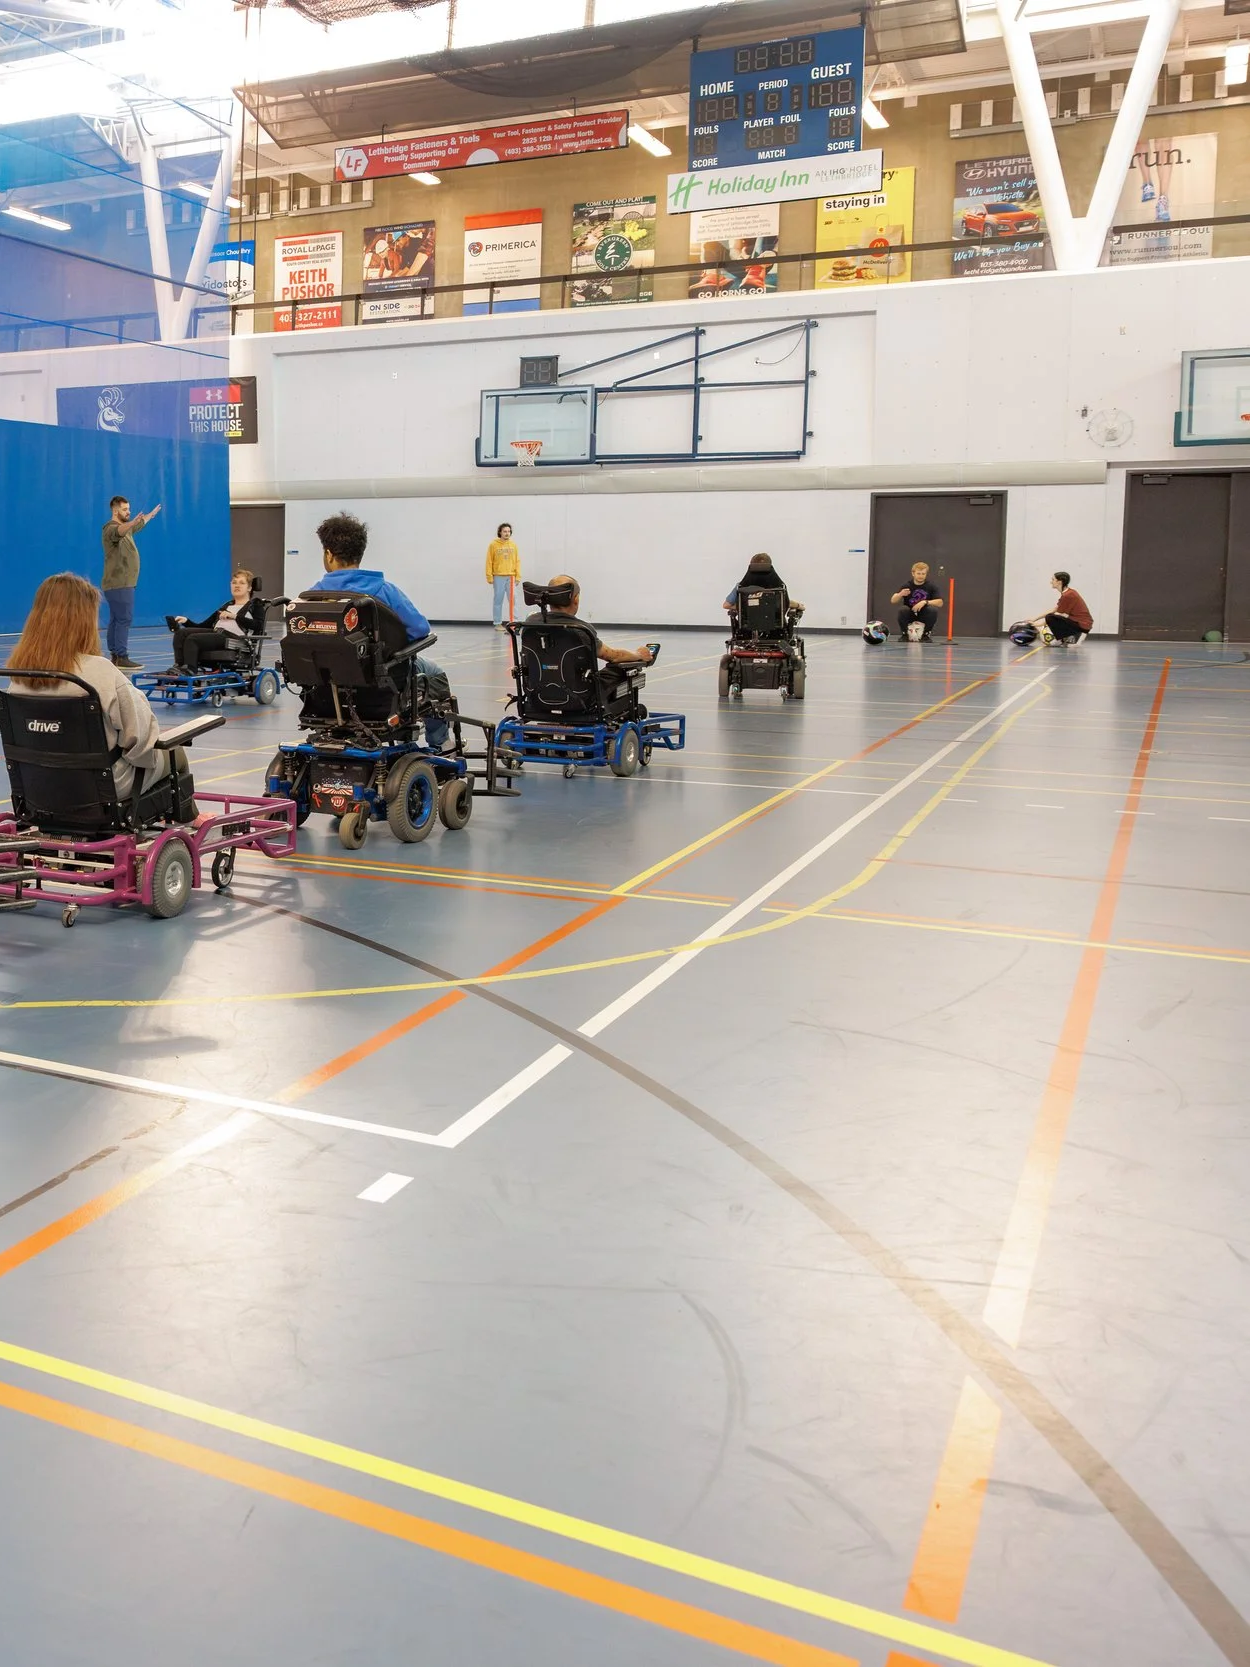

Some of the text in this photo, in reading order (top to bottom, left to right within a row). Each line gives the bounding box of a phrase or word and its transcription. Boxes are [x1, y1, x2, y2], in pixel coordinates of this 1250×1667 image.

[811, 62, 853, 79] GUEST
[700, 81, 734, 97] HOME
[758, 79, 789, 91] PERIOD
[829, 106, 857, 118] FOULS
[522, 125, 546, 135] Fastener
[554, 121, 572, 130] Safety
[573, 119, 596, 128] Product
[597, 115, 623, 125] Provider
[743, 114, 802, 129] PLAYER FOUL
[553, 132, 576, 141] Avenue
[576, 129, 594, 138] North
[694, 125, 719, 136] FOULS
[368, 134, 480, 157] Lethbridge Fasteners & Tools
[827, 140, 856, 152] SCORE
[383, 147, 460, 163] Proudly Supporting Our
[758, 149, 786, 160] MATCH
[1128, 146, 1191, 170] run.
[403, 159, 440, 170] Community
[692, 158, 718, 169] SCORE
[815, 163, 879, 177] AN IHG HOTEL
[707, 170, 810, 197] Holiday Inn
[986, 181, 1009, 193] won't
[1012, 177, 1027, 188] sell
[628, 195, 645, 203] PLAY!
[825, 194, 885, 210] staying in
[281, 244, 308, 256] ROYAL
[485, 240, 537, 252] PRIMERICA
[953, 249, 975, 262] We'll
[996, 247, 1011, 256] you
[1013, 241, 1030, 252] Buy
[289, 267, 328, 285] KEITH
[282, 283, 335, 301] PUSHOR
[698, 291, 713, 299] GO
[748, 286, 767, 296] GO!
[189, 403, 241, 420] PROTECT
[189, 419, 244, 433] THIS HOUSE.
[28, 719, 60, 733] drive
